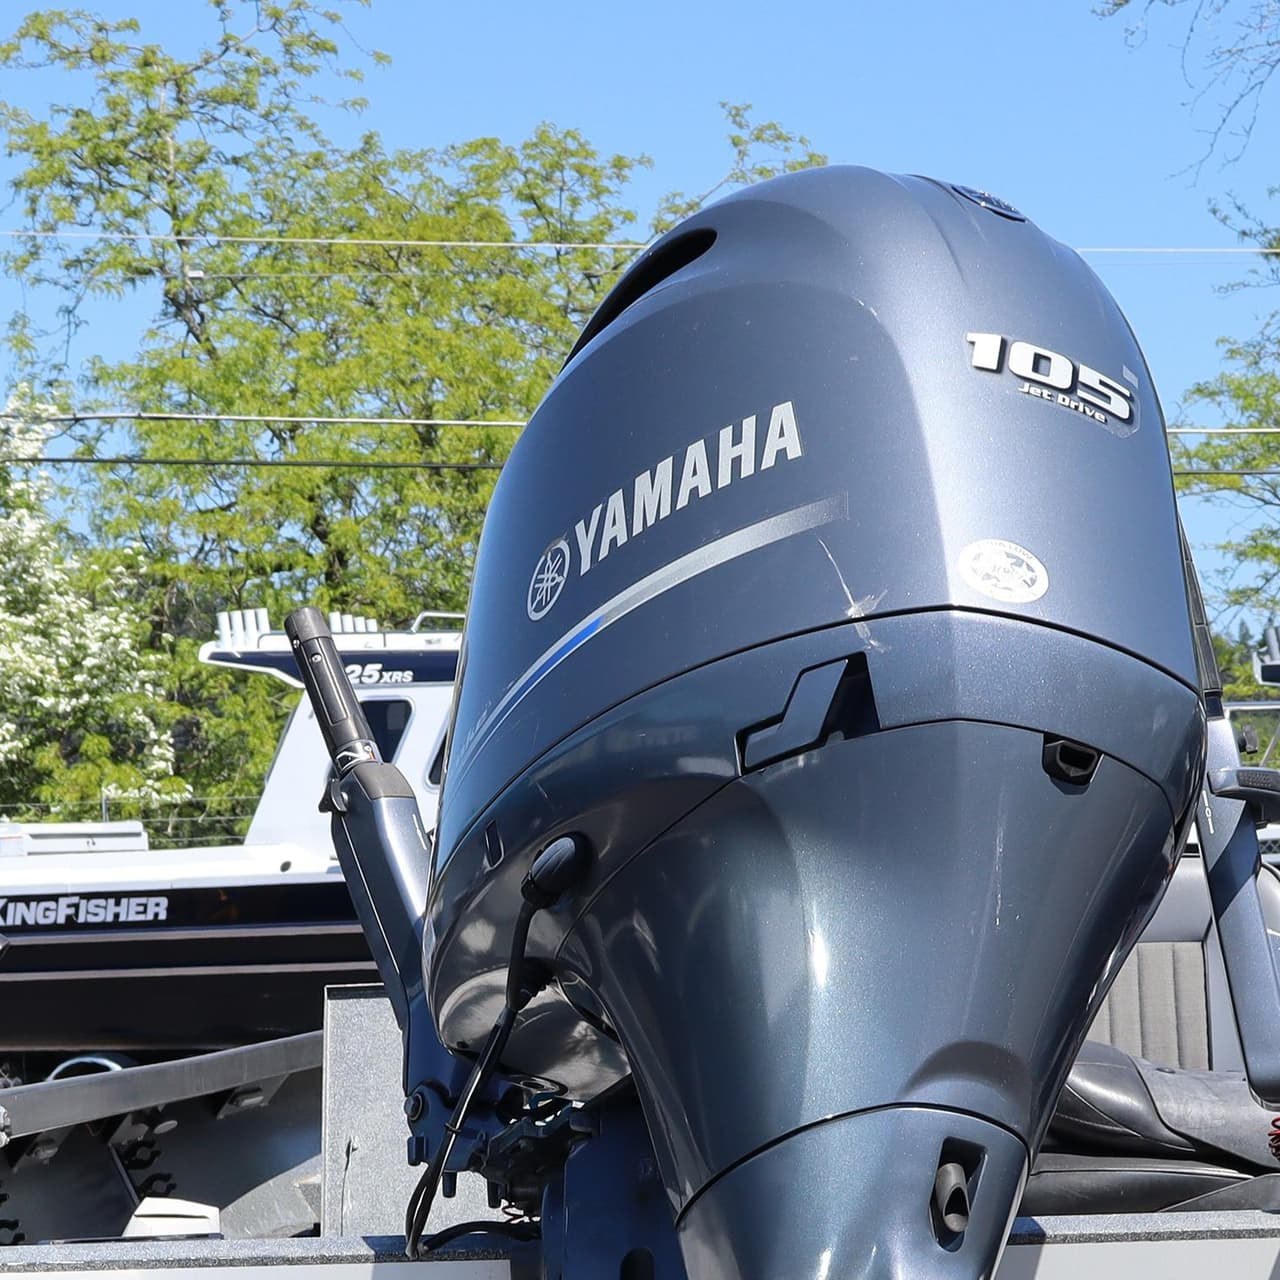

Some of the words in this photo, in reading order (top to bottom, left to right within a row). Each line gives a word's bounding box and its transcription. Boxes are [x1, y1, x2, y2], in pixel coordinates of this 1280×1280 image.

[966, 332, 1131, 421] 105
[1018, 382, 1052, 400] Jet
[1057, 392, 1106, 423] Drive
[574, 400, 803, 577] YAMAHA
